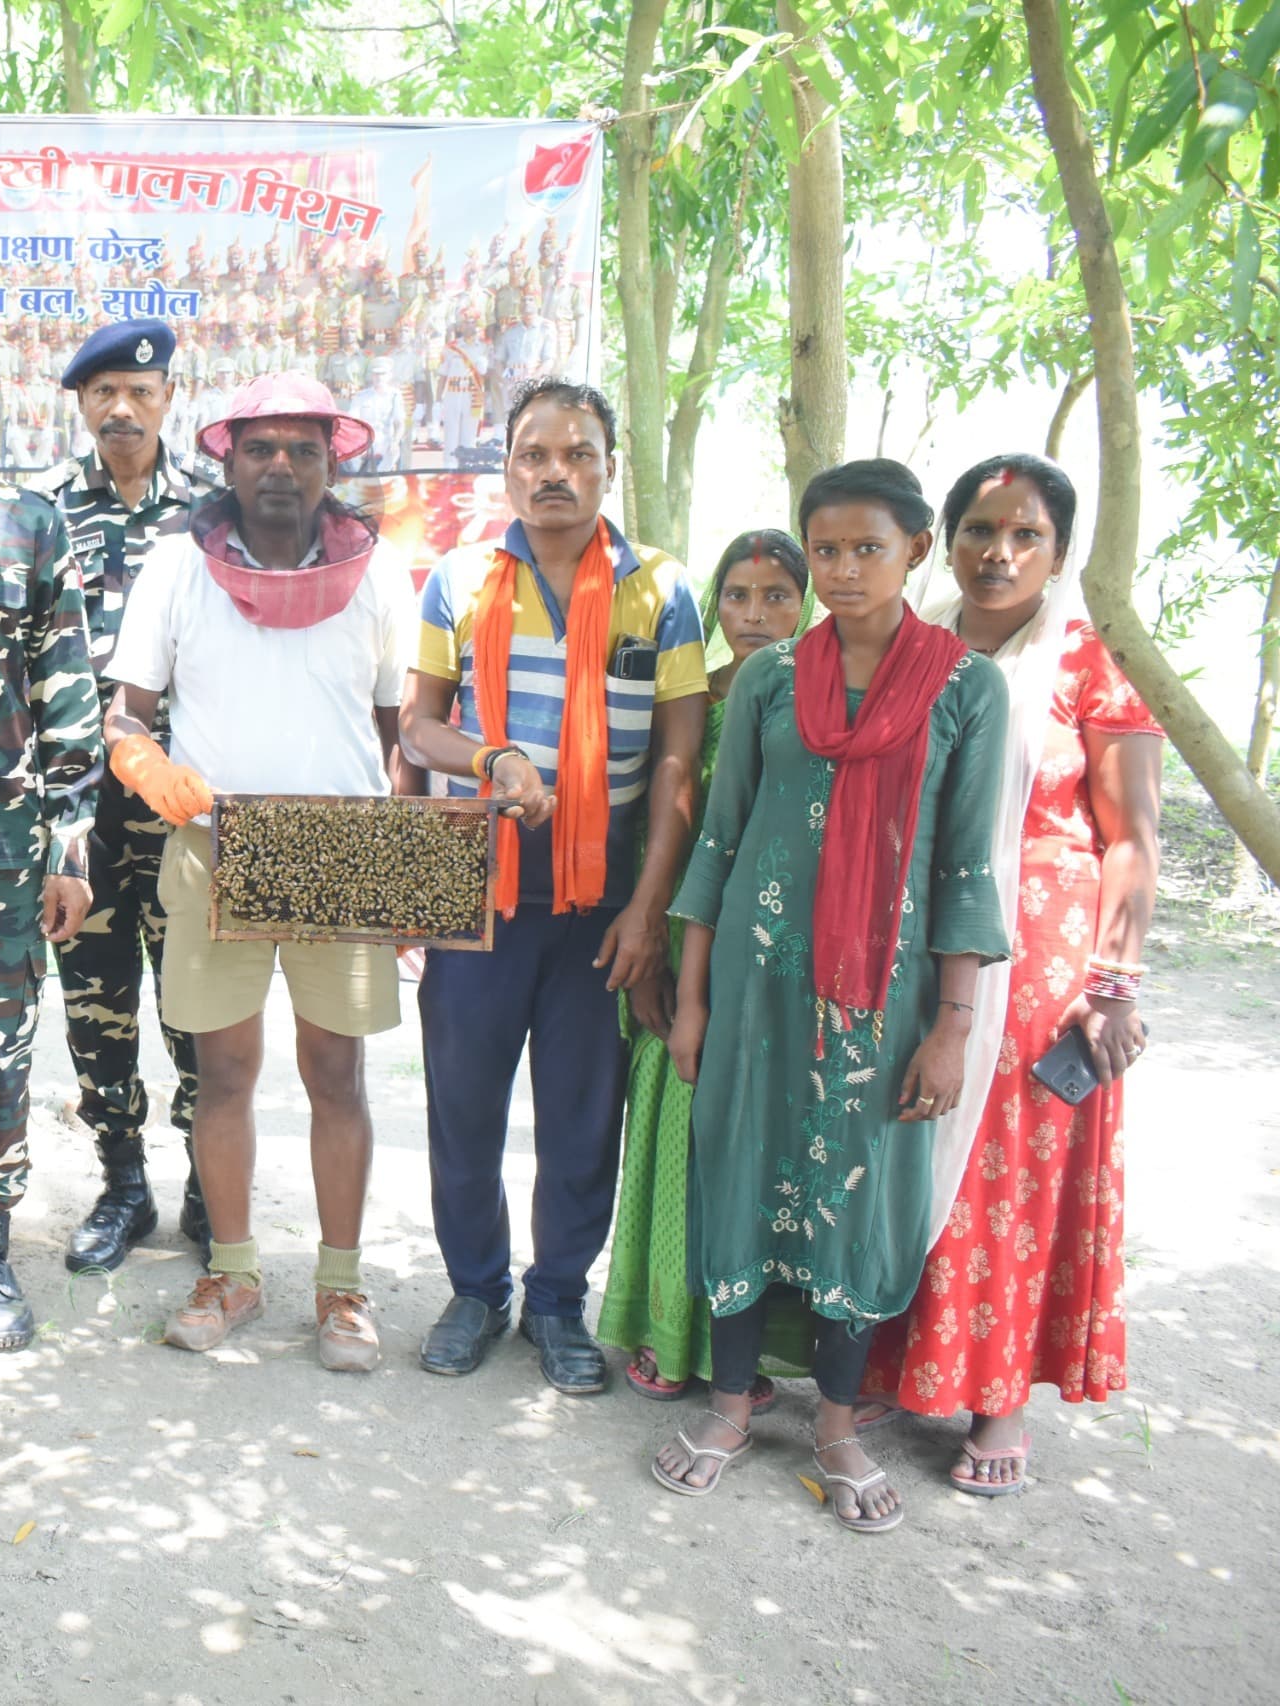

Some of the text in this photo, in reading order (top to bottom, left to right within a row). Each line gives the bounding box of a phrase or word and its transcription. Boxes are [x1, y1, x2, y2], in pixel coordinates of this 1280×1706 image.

[90, 161, 225, 206] पालन
[240, 167, 383, 241] मिशन
[87, 228, 163, 265] केन्द्र
[19, 288, 85, 320] बल,
[102, 280, 200, 322] सुपौल
